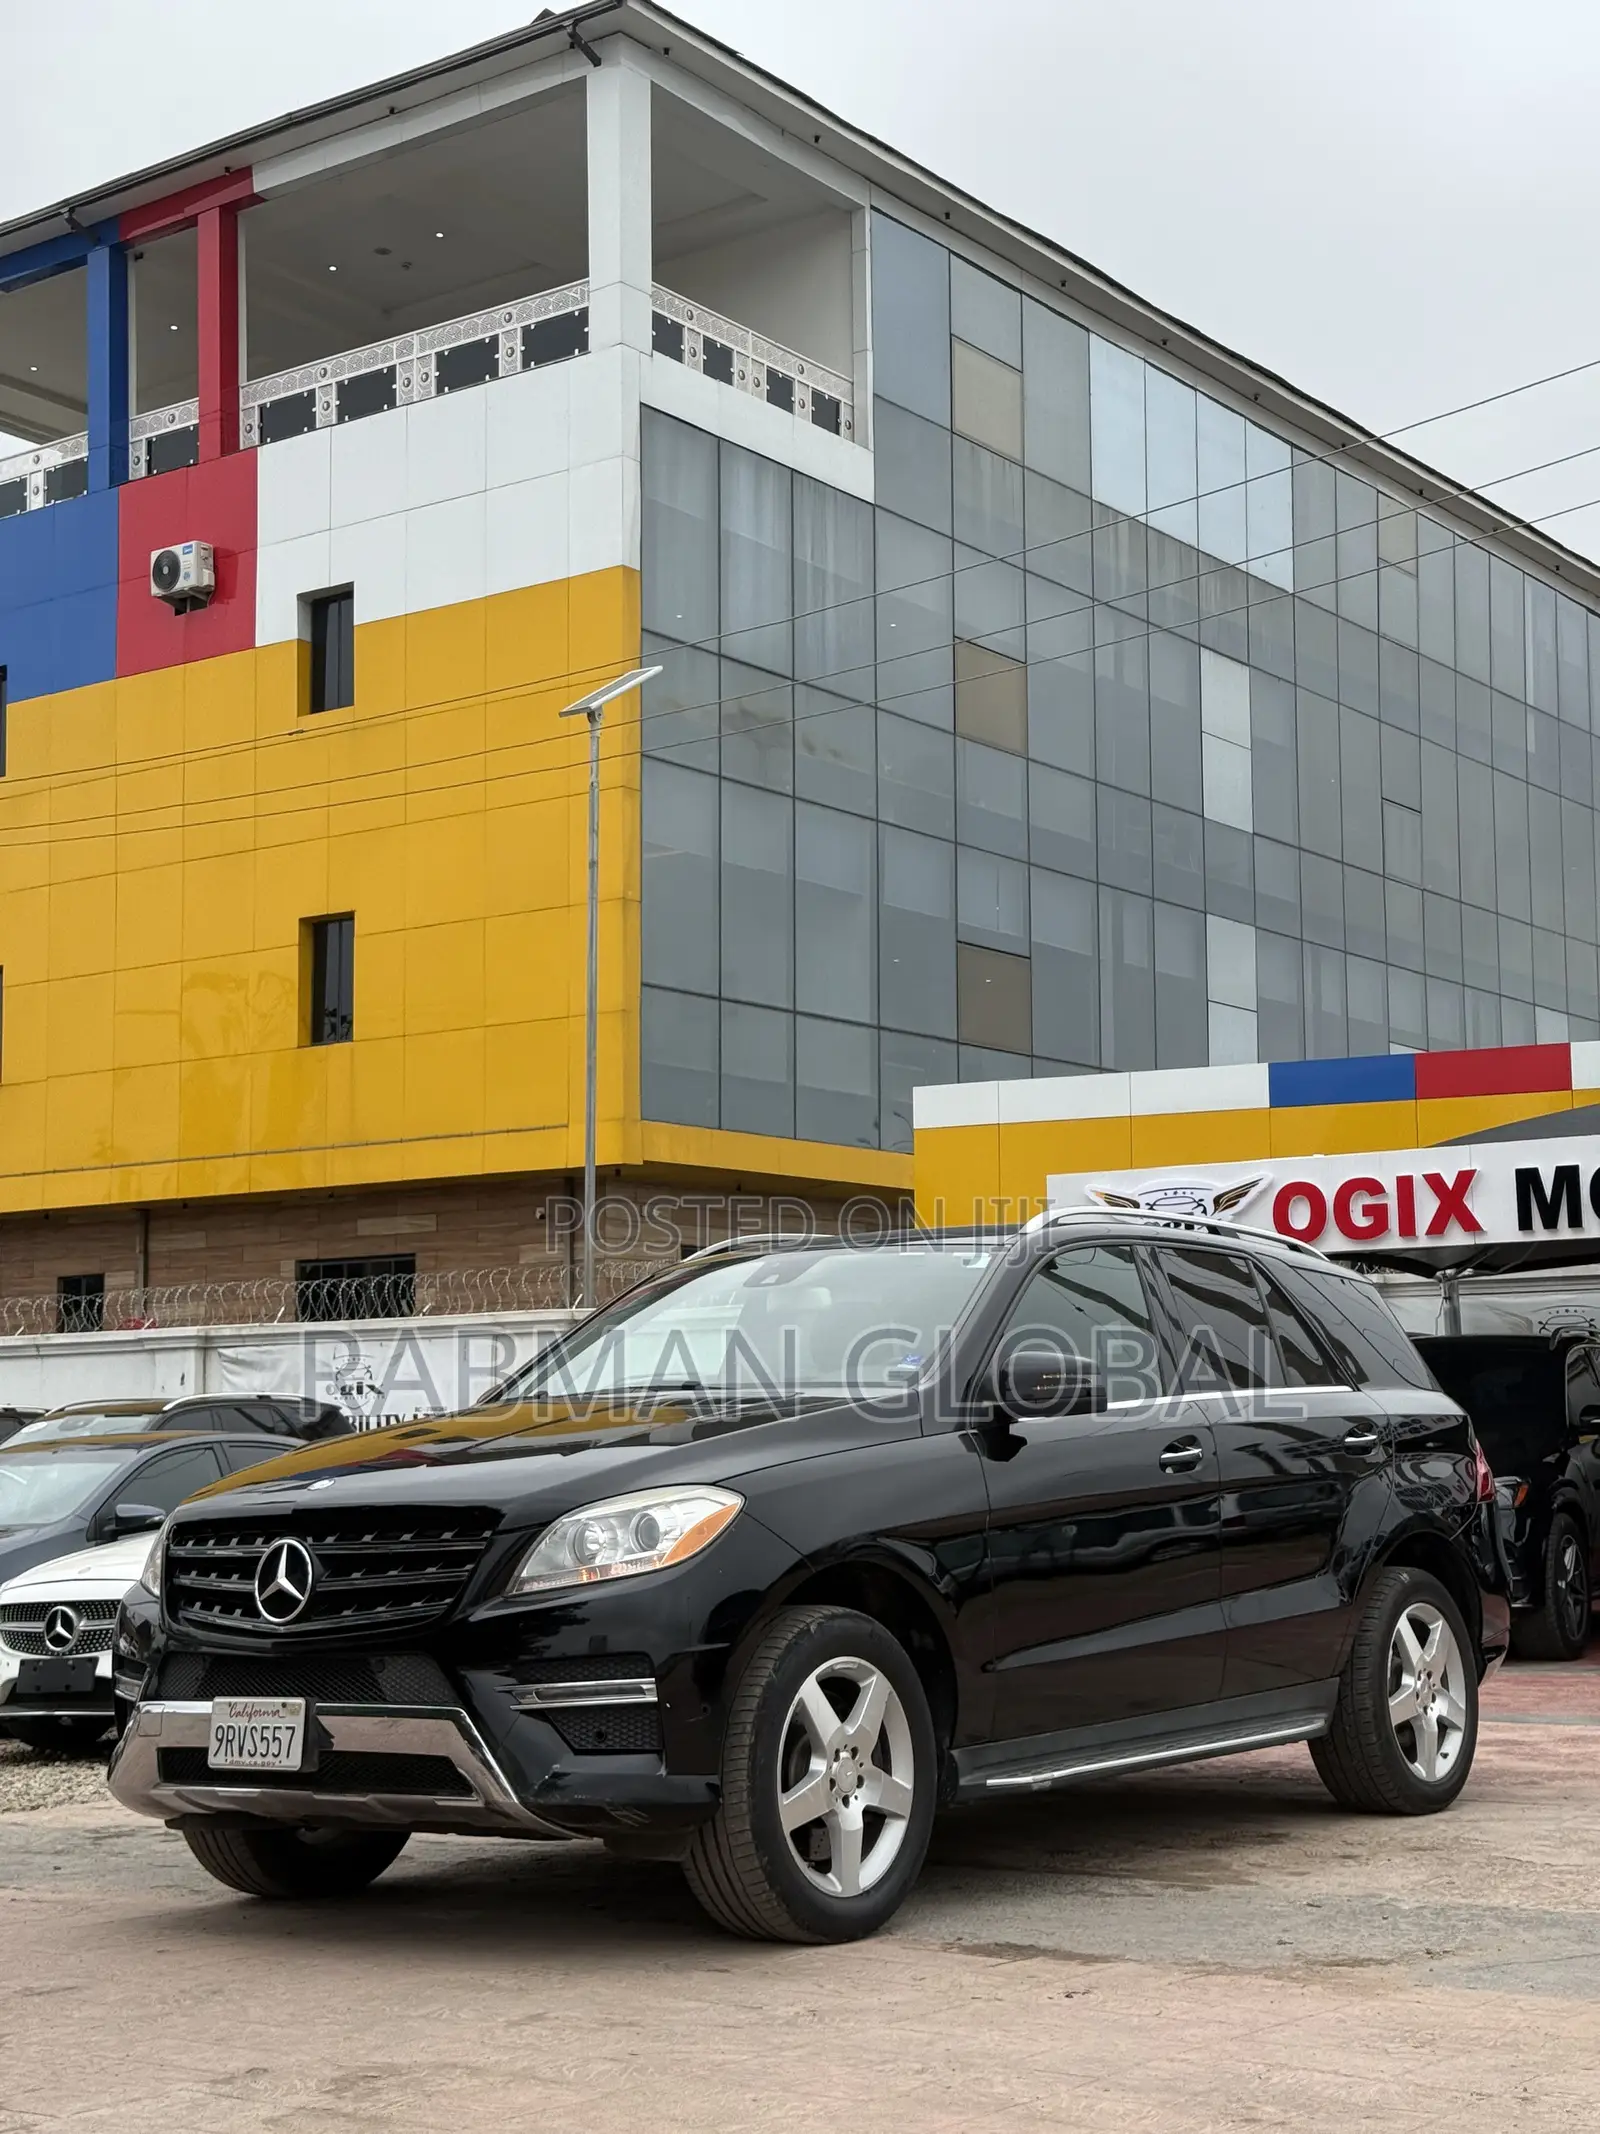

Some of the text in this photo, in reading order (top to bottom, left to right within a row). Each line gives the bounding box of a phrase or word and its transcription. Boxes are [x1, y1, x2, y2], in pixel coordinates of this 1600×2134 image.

[1273, 1168, 1486, 1244] OGIX
[229, 1702, 287, 1723] California
[213, 1725, 297, 1760] 9RVS557
